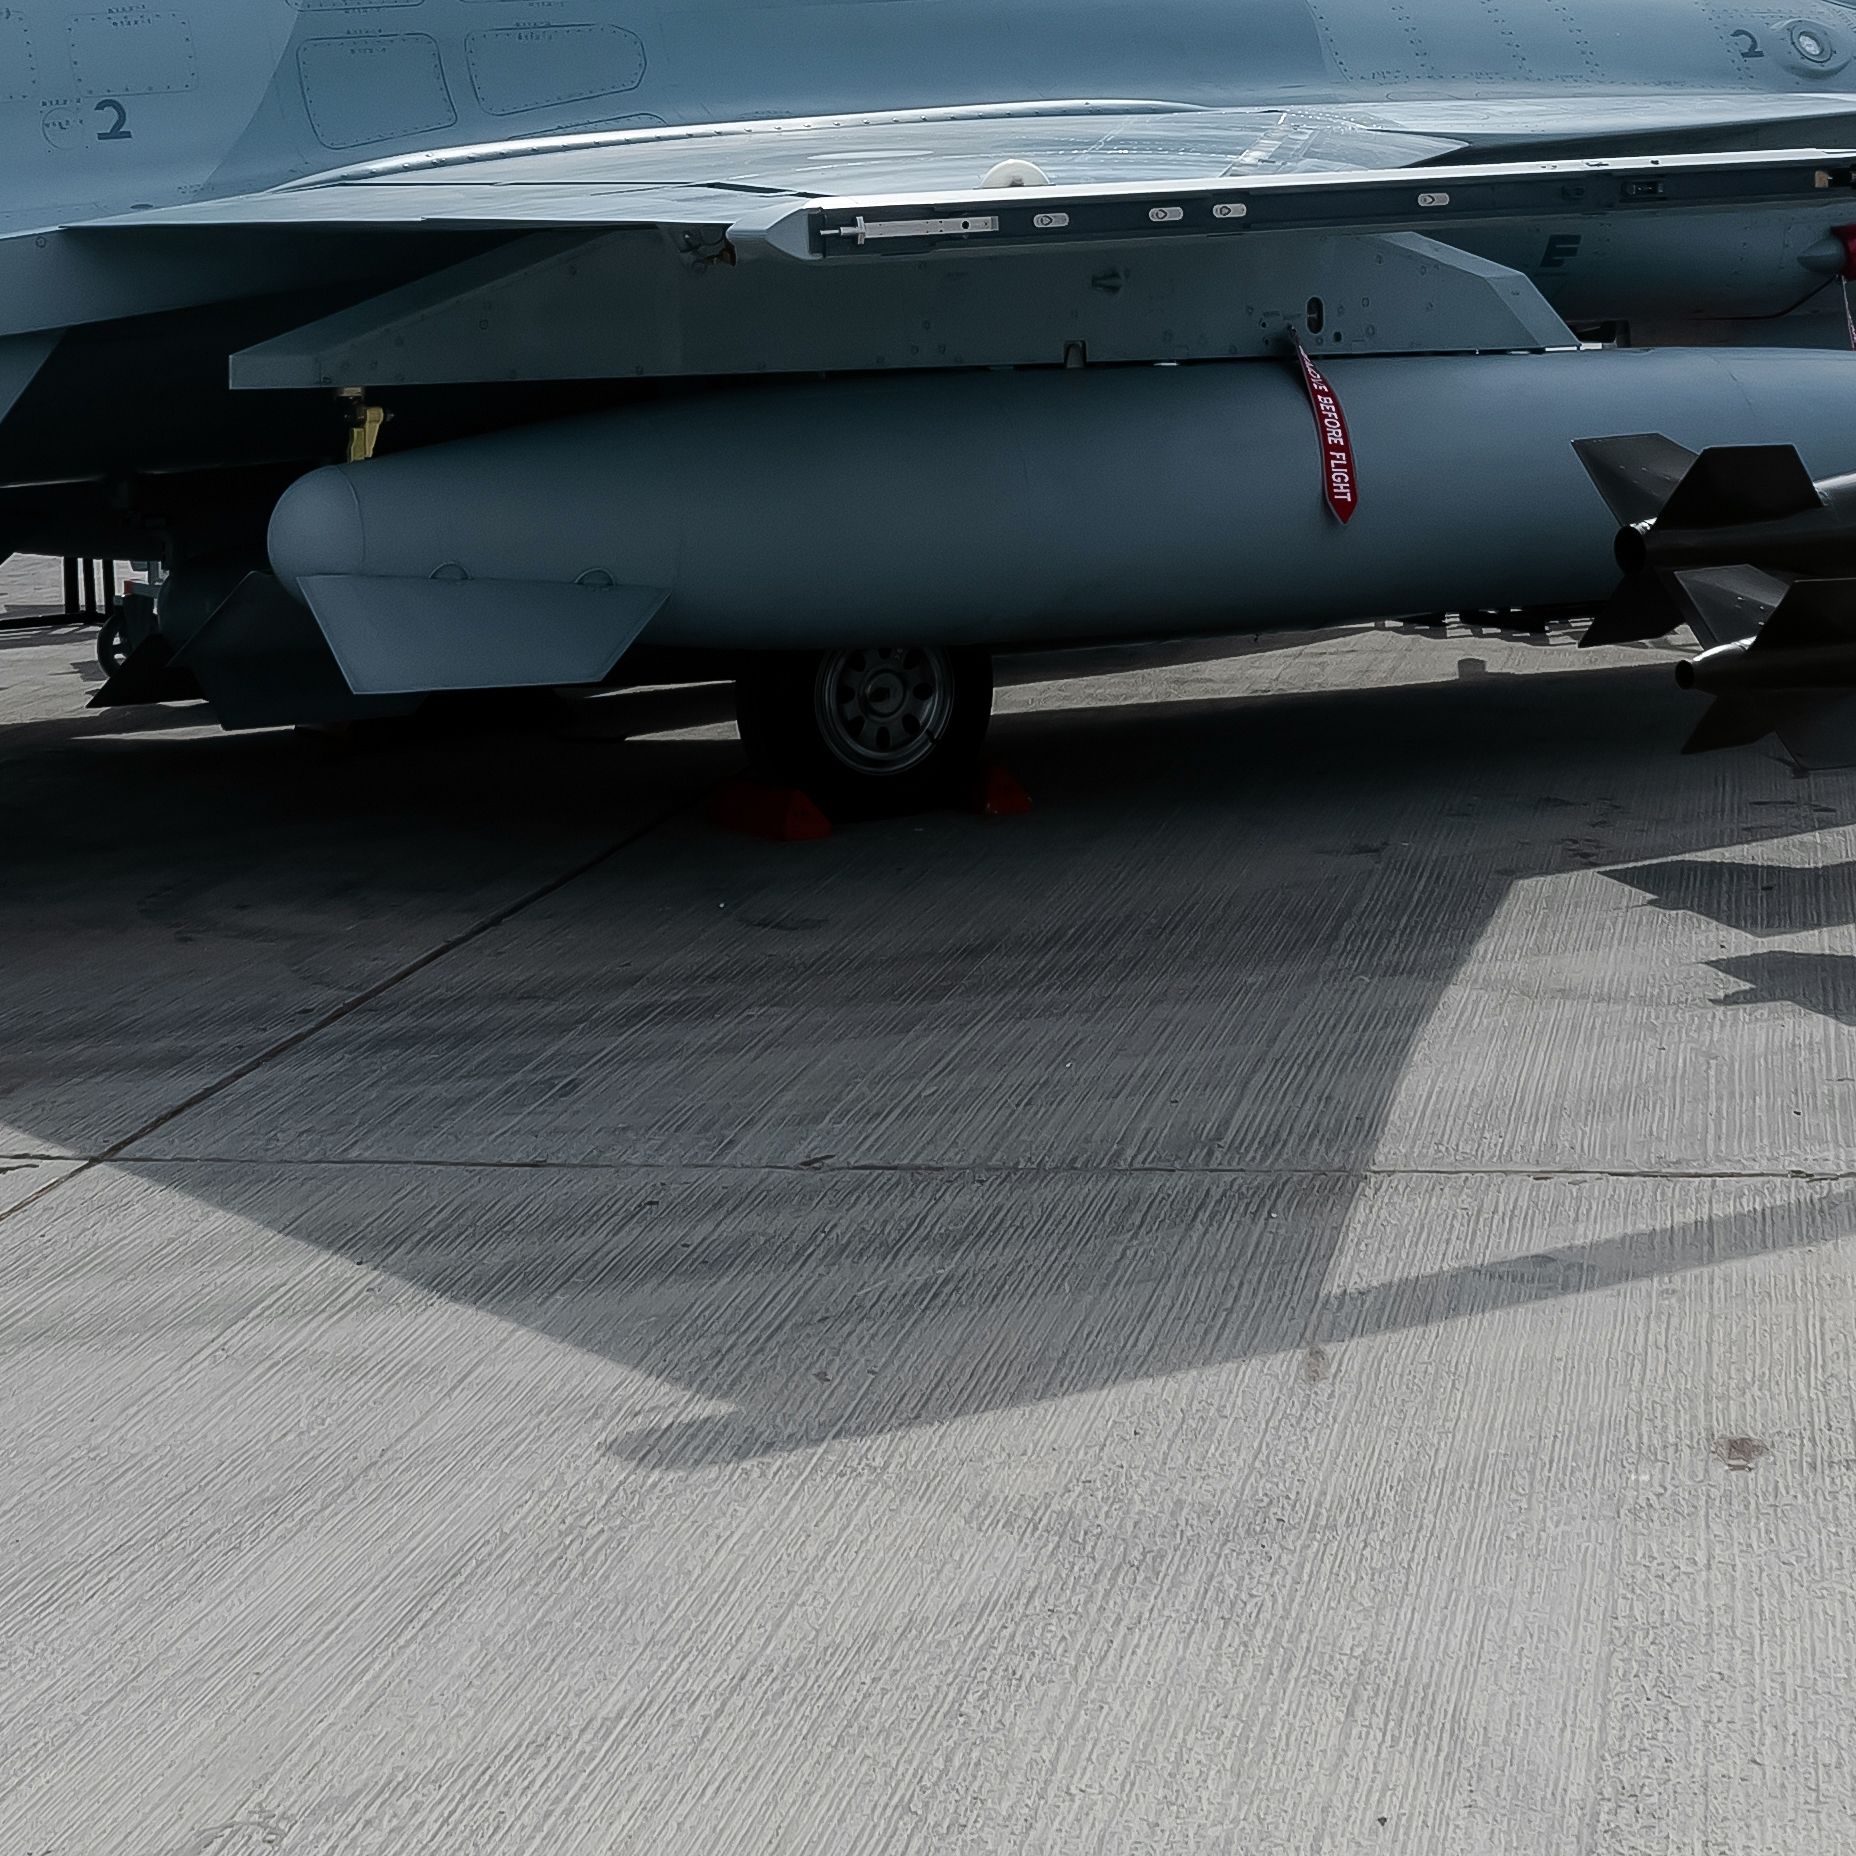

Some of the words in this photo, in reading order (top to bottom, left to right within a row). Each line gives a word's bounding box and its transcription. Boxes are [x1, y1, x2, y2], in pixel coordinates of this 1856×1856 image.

[94, 98, 132, 140] 2
[1318, 394, 1344, 446] BEFORE
[1330, 451, 1352, 502] FLIGHT
